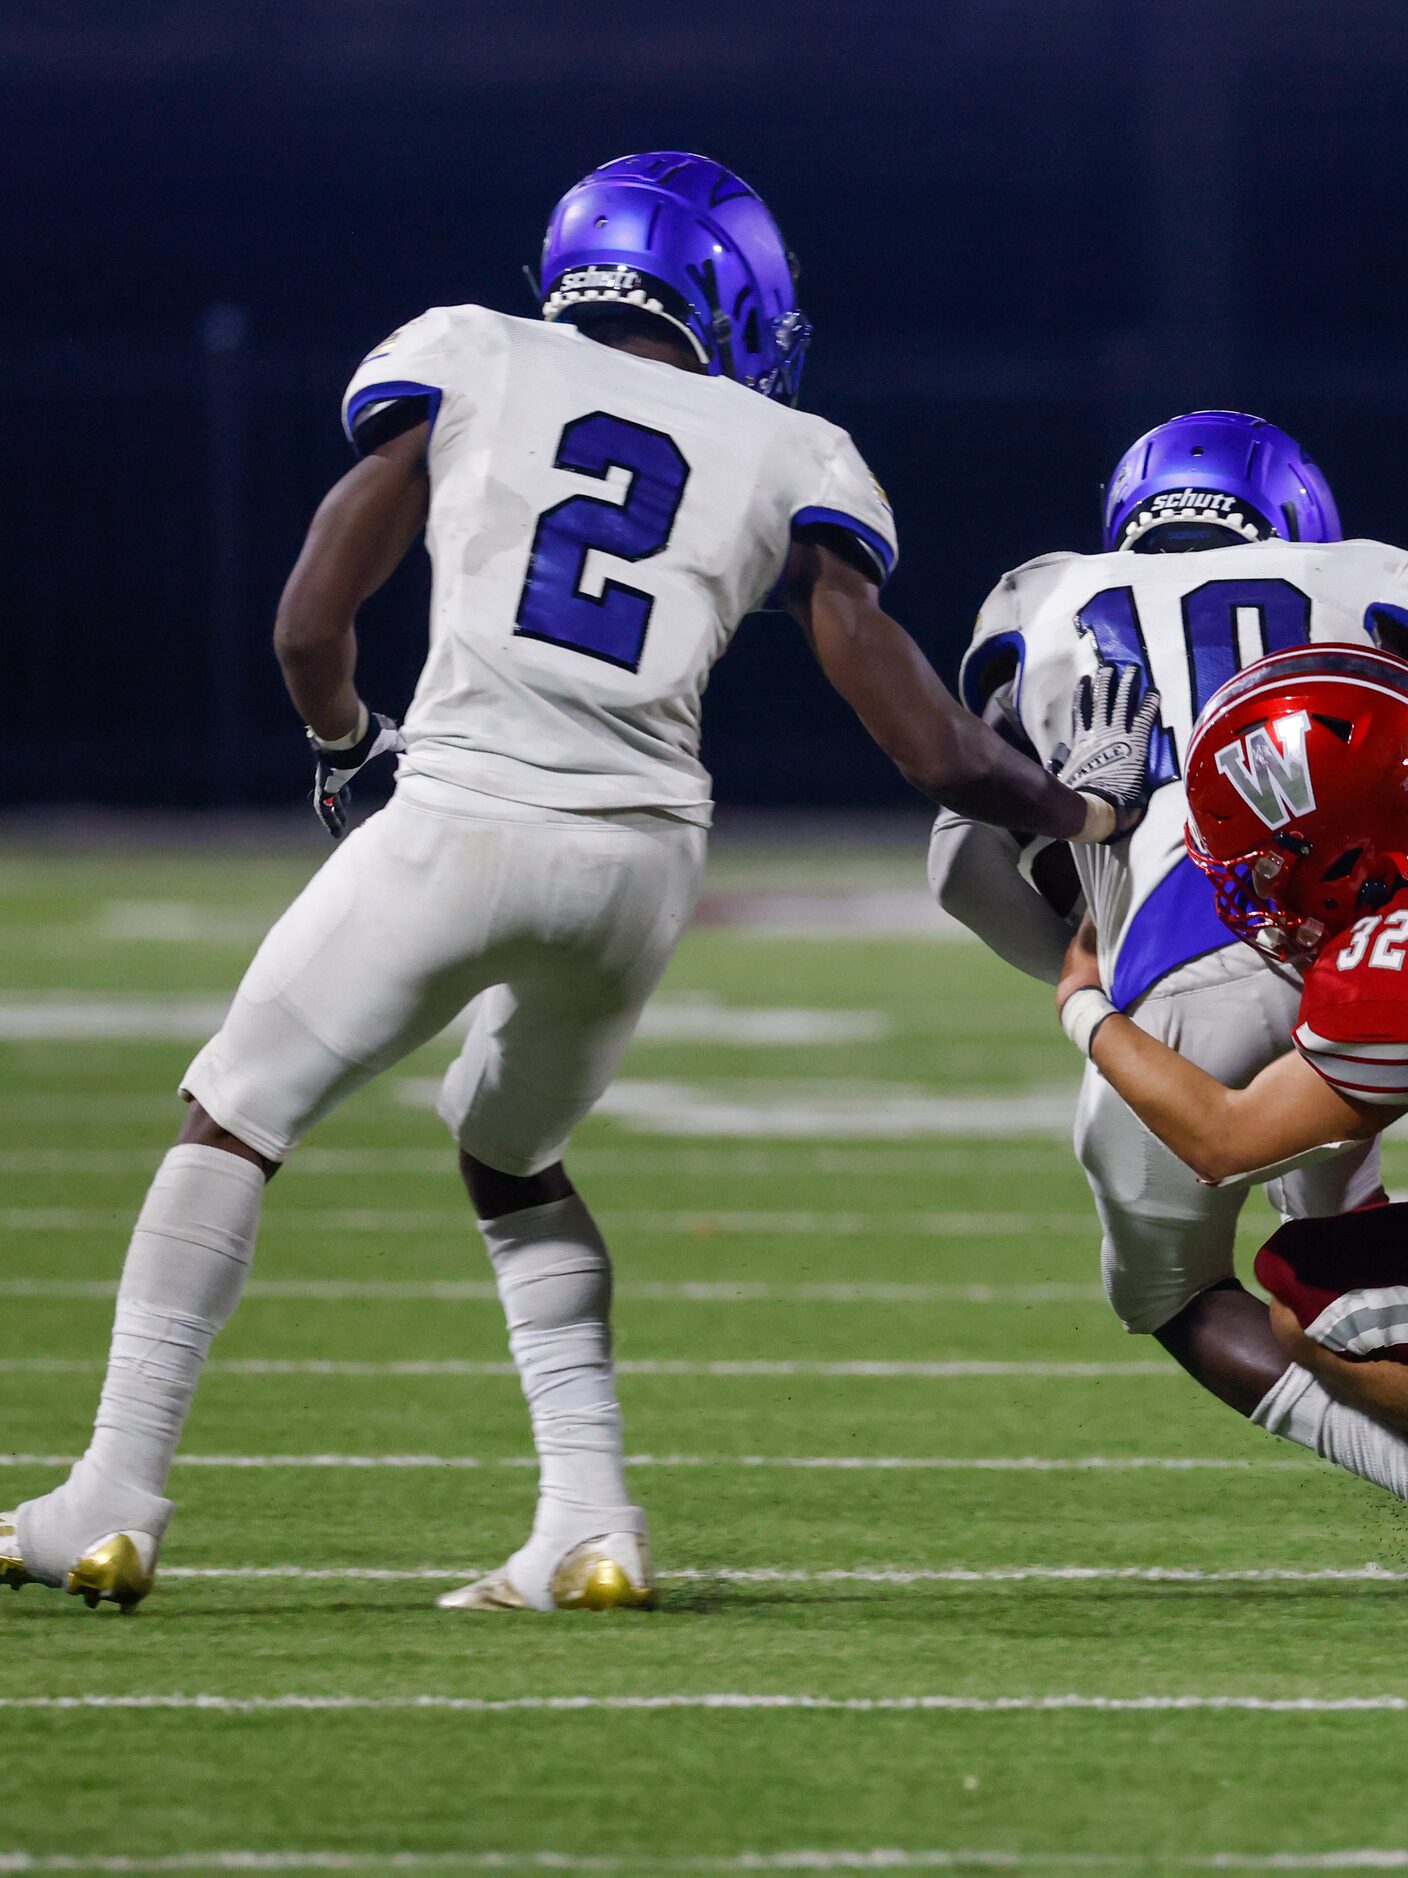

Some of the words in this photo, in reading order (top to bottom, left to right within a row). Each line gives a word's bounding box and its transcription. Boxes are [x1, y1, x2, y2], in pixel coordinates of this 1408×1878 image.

[513, 410, 690, 674] 2
[1150, 488, 1237, 512] schutt
[1215, 709, 1317, 831] W
